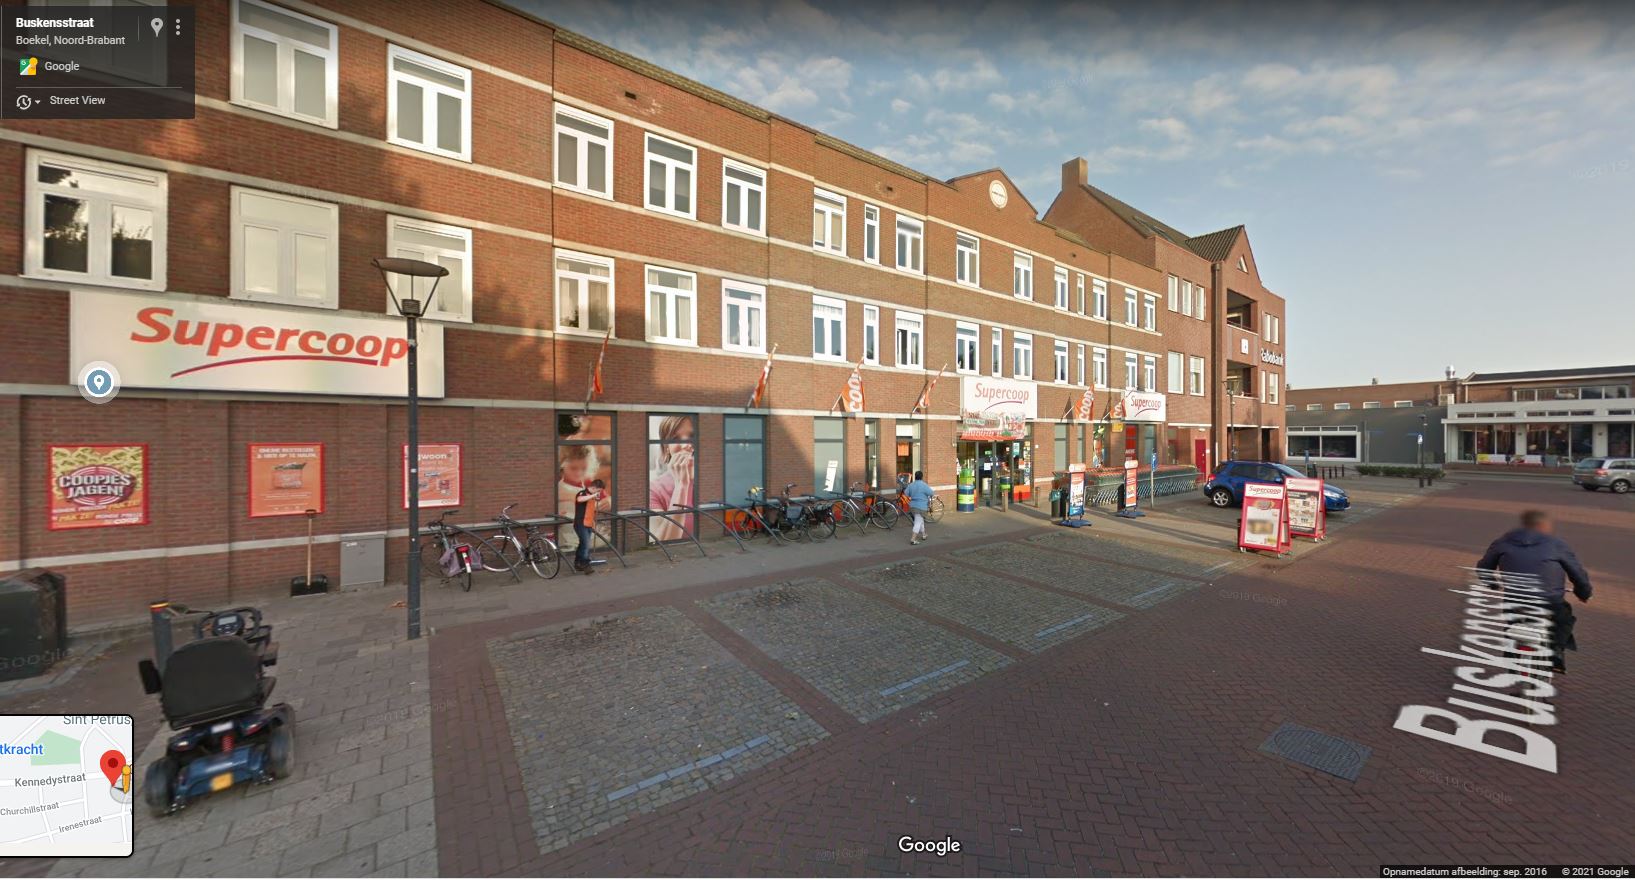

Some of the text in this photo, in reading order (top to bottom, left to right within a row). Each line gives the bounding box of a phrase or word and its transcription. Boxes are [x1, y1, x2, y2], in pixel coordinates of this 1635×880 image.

[131, 306, 409, 367] Supercoop
[974, 382, 1030, 405] Supercoop
[1130, 395, 1162, 409] Supercoop
[59, 473, 132, 488] COOPJES
[66, 484, 124, 499] JAGEN!
[1248, 485, 1281, 495] Supercoop
